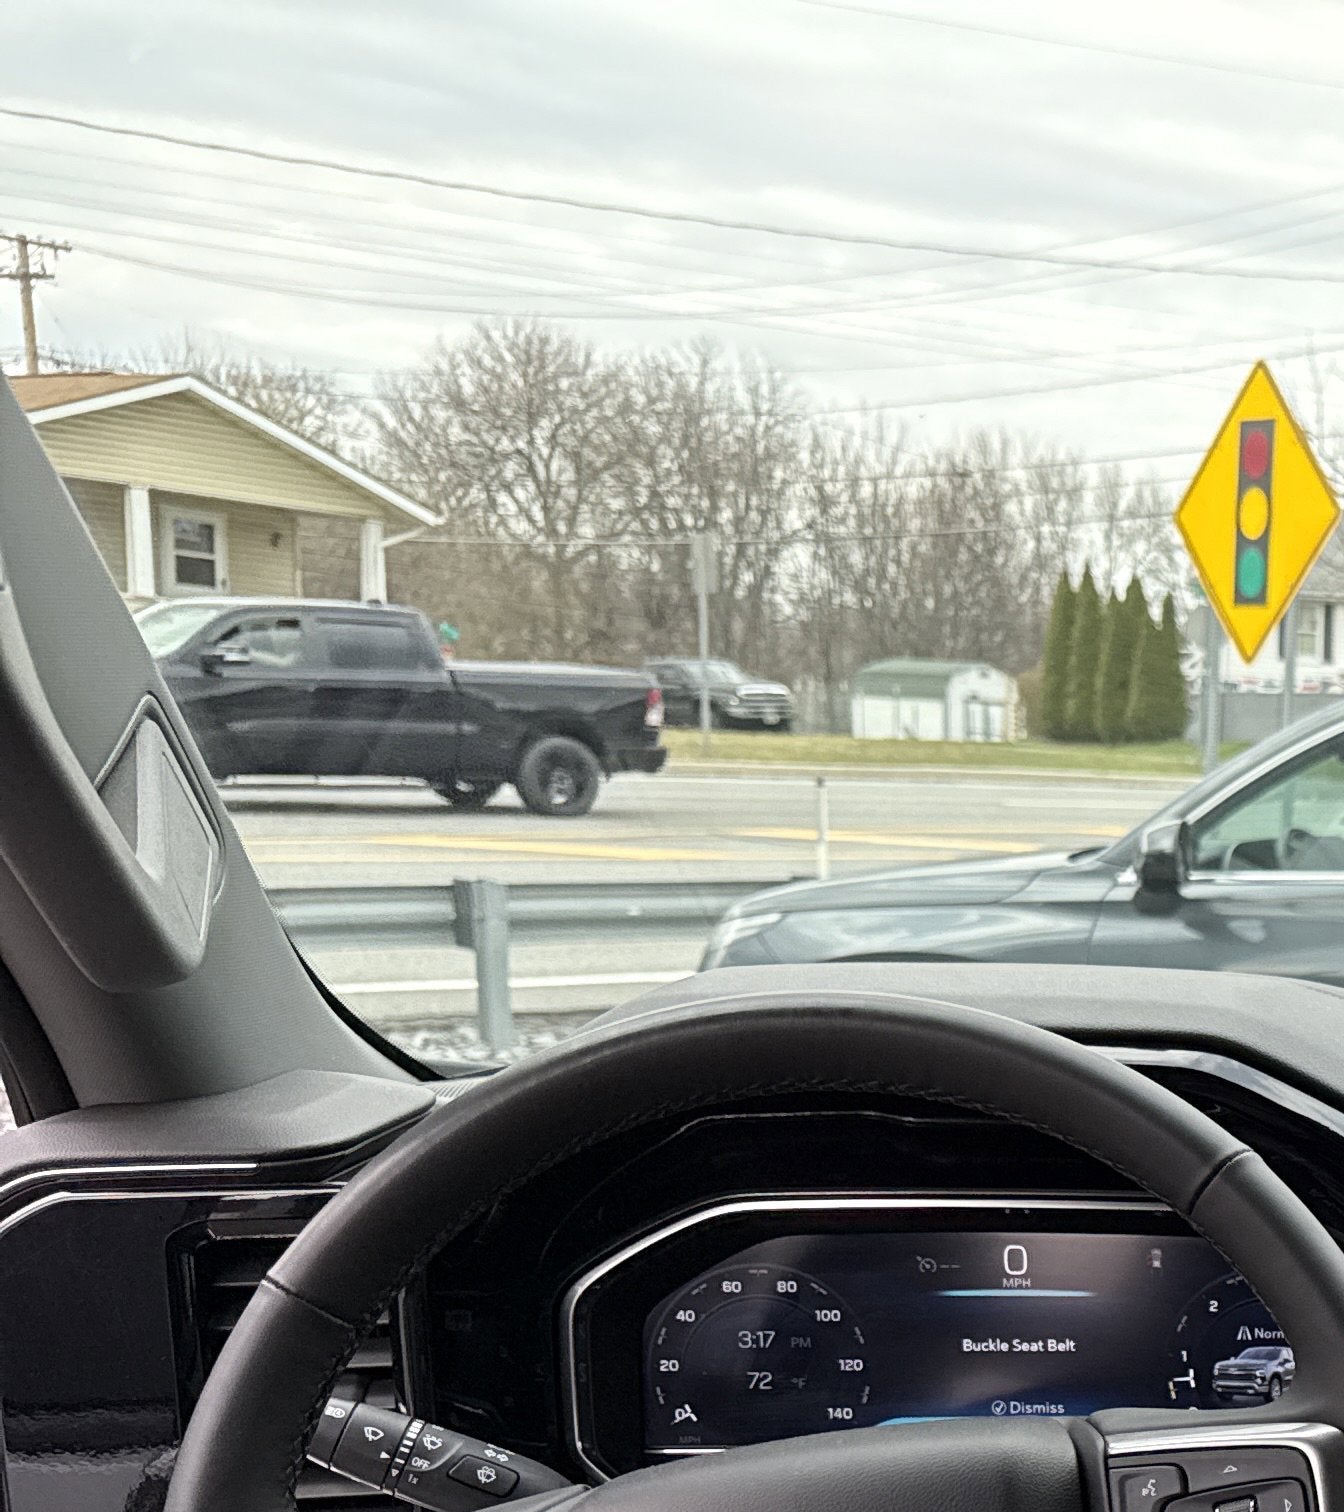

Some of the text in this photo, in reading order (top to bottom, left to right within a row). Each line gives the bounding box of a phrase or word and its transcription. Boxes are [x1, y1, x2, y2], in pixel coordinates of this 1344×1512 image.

[1003, 1244, 1028, 1275] 0
[722, 1280, 742, 1293] 60
[776, 1280, 797, 1293] 80
[1002, 1277, 1031, 1288] MPH
[1209, 1300, 1219, 1313] 2
[676, 1309, 696, 1322] 40
[815, 1309, 841, 1322] 100
[738, 1331, 812, 1349] 3:17 PM
[962, 1338, 1077, 1352] Buckle Seat Belt
[659, 1359, 679, 1372] 20
[838, 1358, 864, 1371] 120
[747, 1371, 773, 1390] 72
[827, 1407, 853, 1420] 140
[1009, 1401, 1065, 1415] Dismiss
[411, 1456, 430, 1470] OFF
